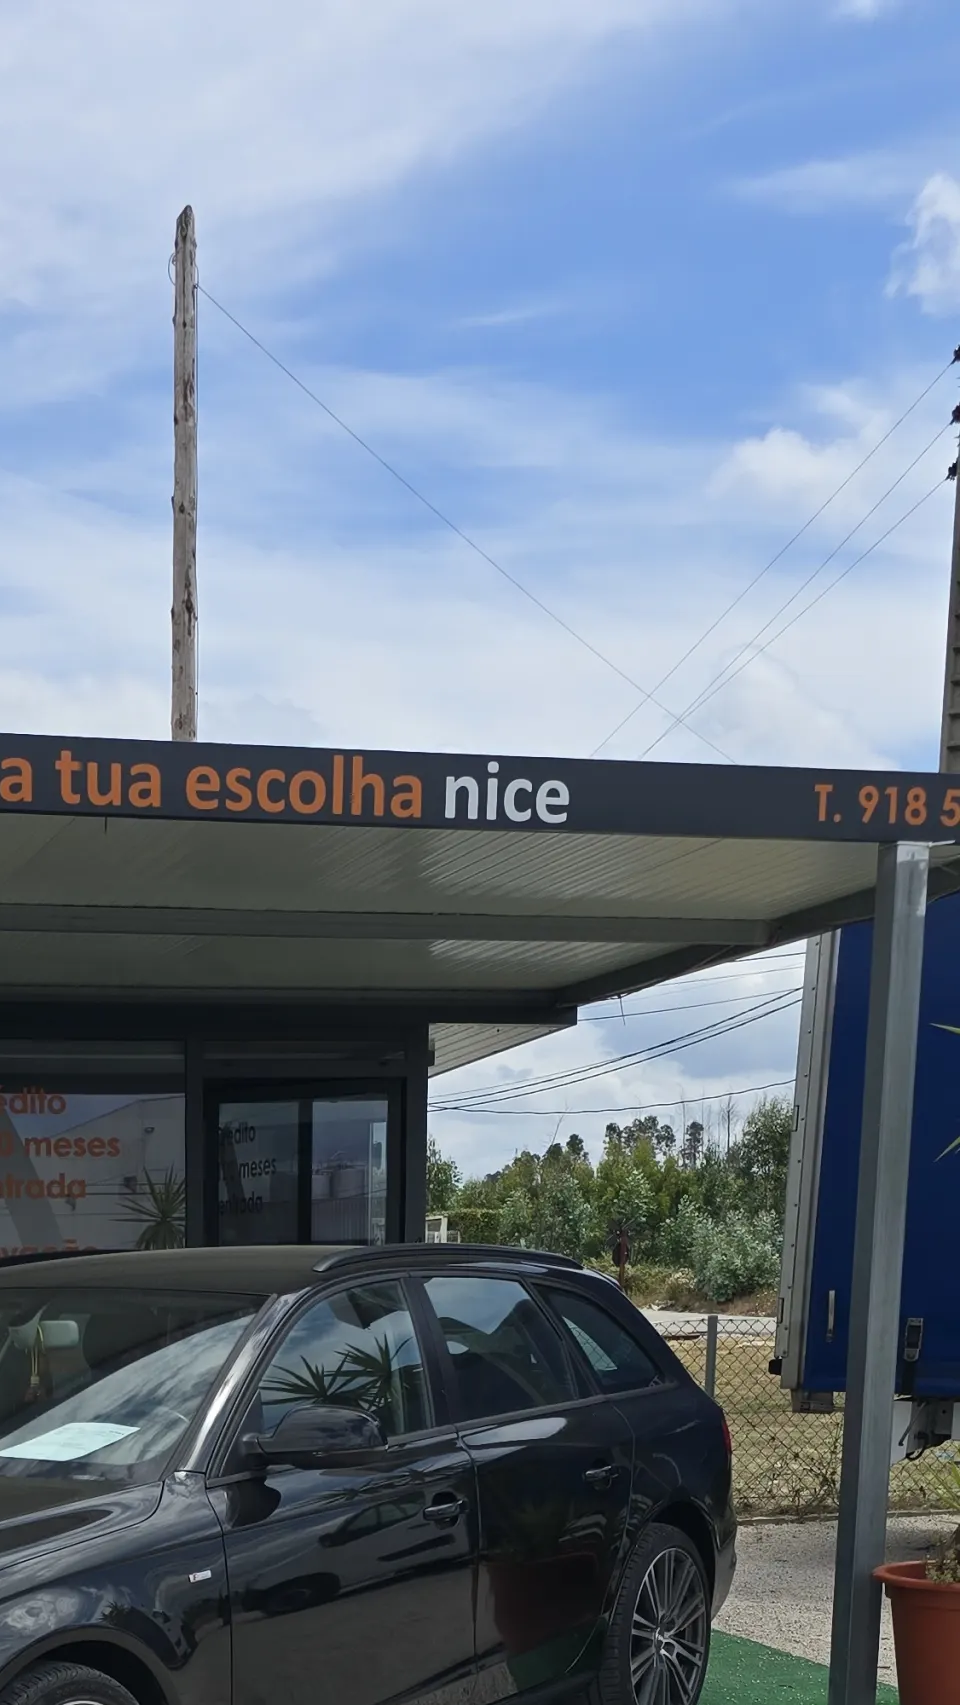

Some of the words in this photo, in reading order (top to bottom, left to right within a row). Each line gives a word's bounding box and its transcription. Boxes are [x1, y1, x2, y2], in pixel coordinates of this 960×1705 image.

[55, 750, 162, 808] tua
[185, 755, 422, 818] escolha
[444, 761, 571, 824] nice
[813, 783, 841, 823] T.
[858, 785, 927, 826] 918
[23, 1135, 121, 1159] meses
